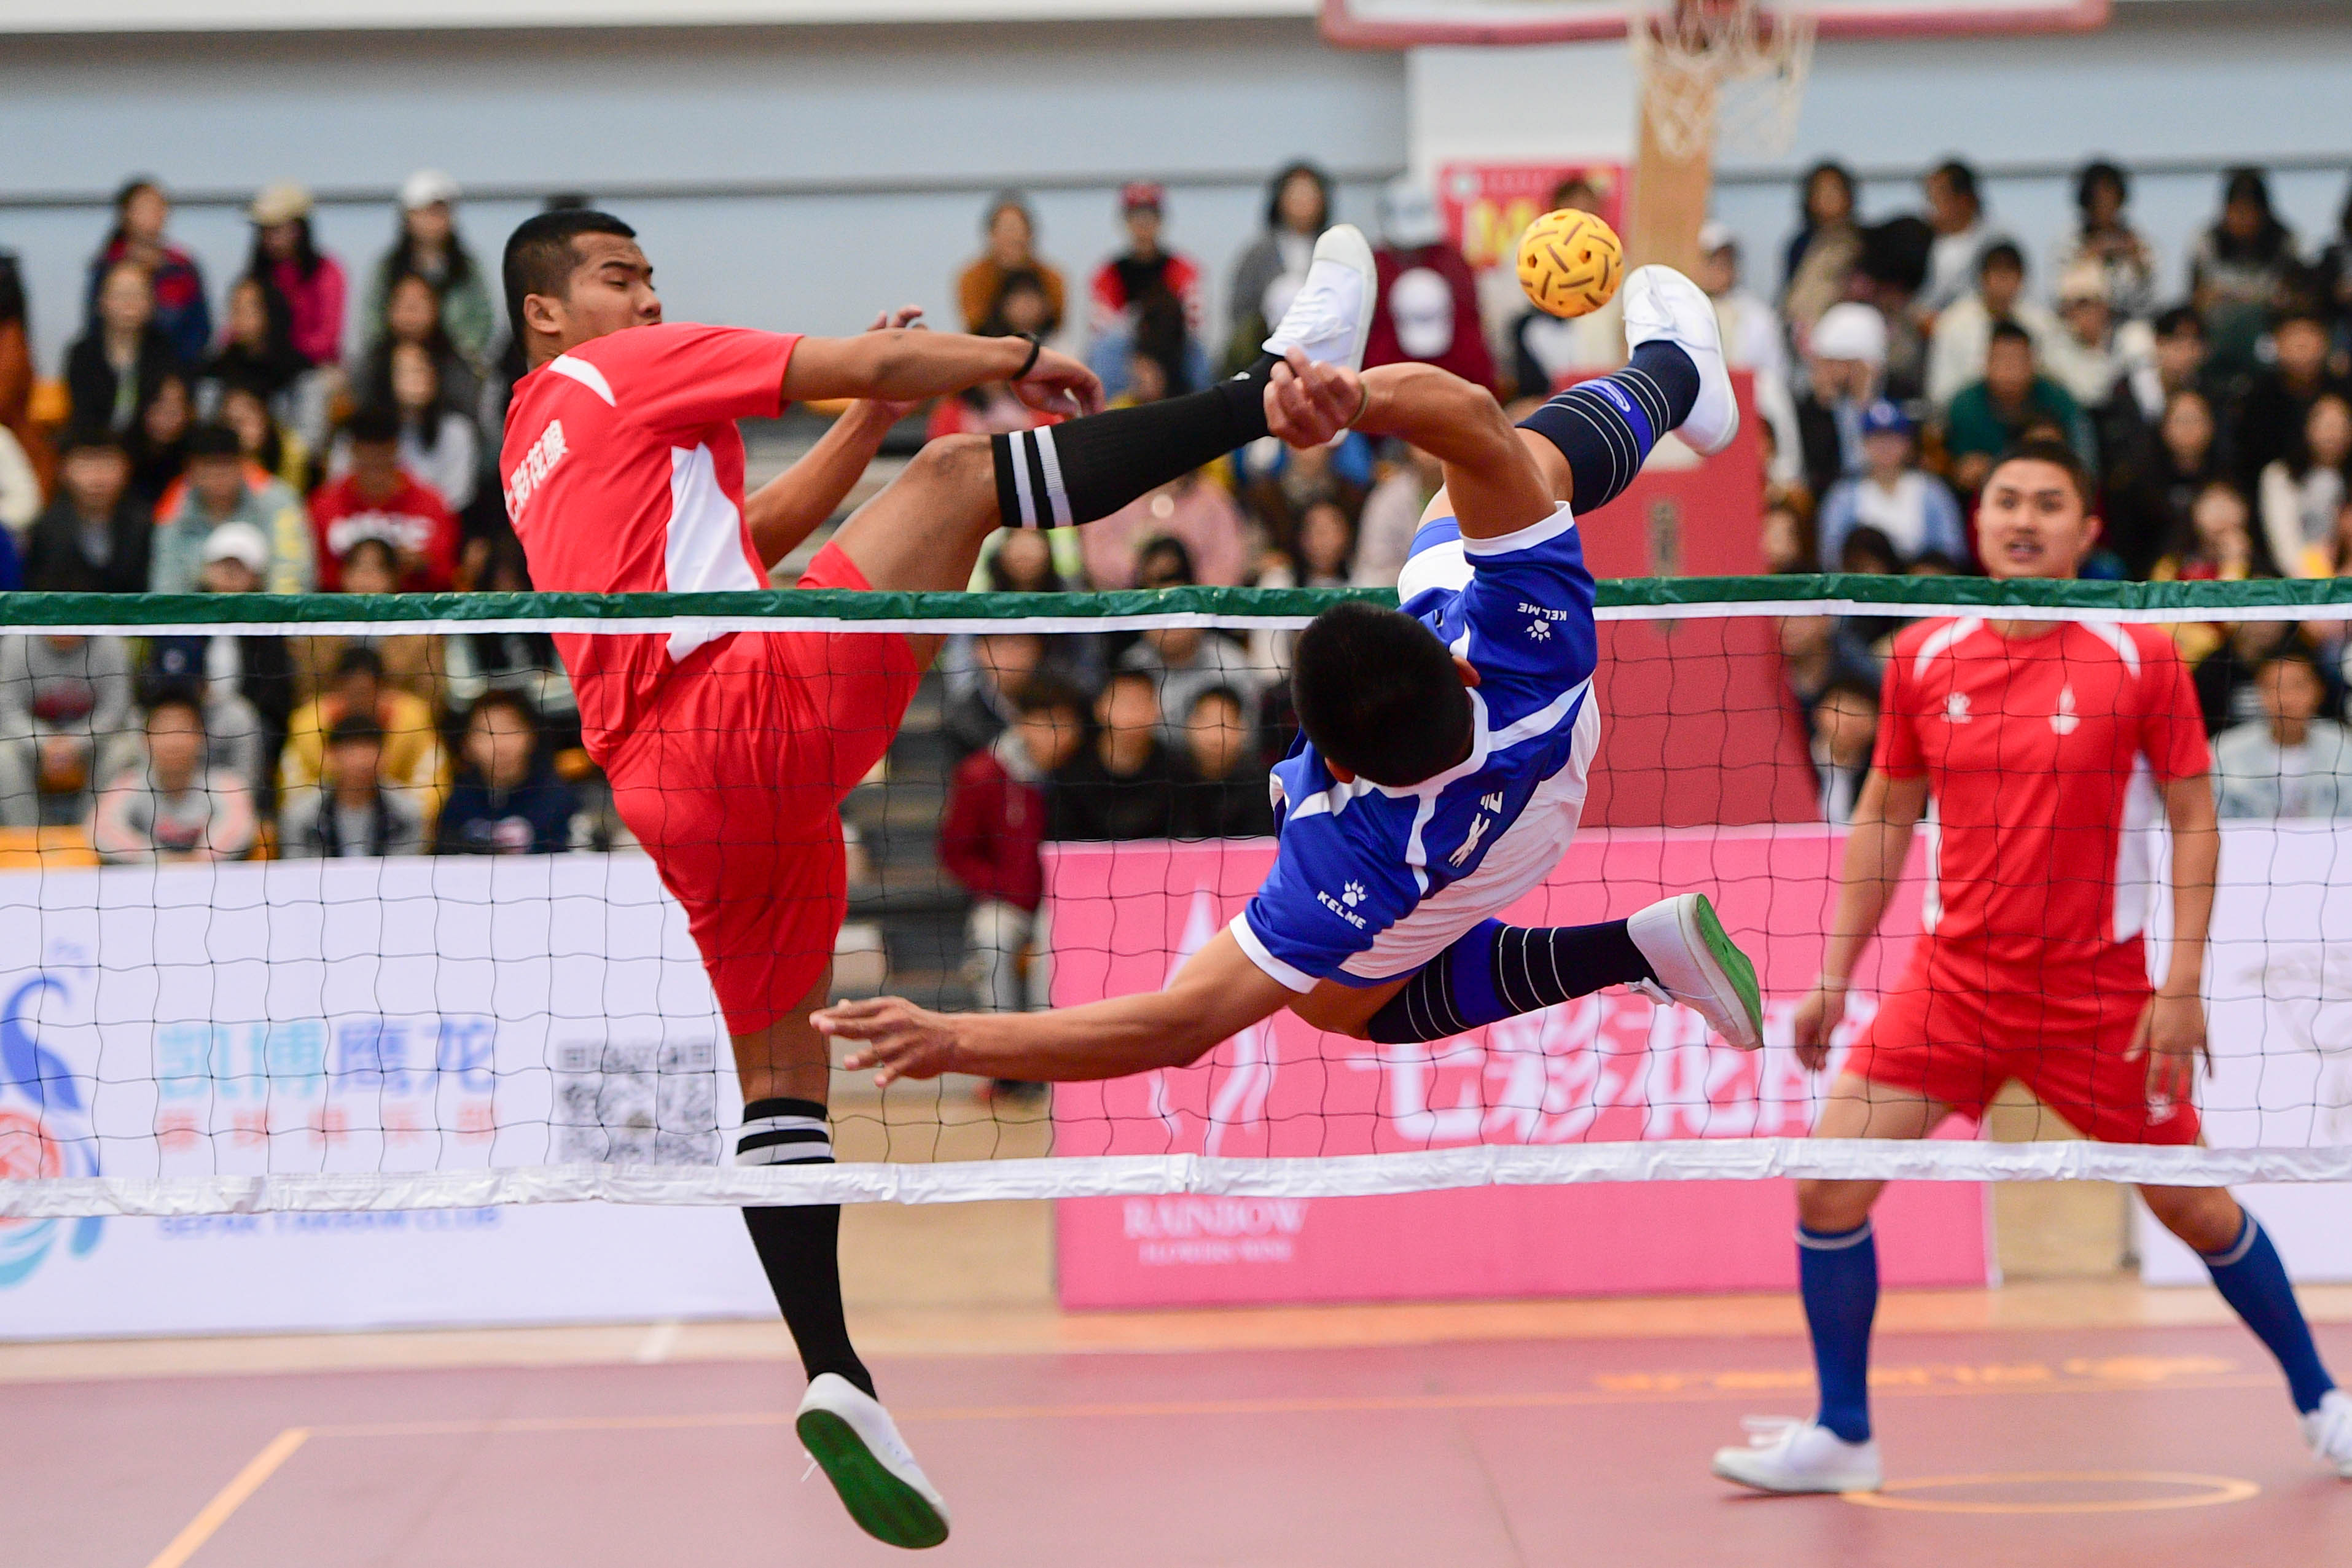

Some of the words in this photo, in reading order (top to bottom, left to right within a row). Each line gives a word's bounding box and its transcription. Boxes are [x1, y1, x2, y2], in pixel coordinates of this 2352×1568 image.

[1517, 603, 1567, 621] KELME
[1317, 891, 1366, 930] KELME
[158, 1020, 498, 1098] 凯博鹰龙
[1123, 1198, 1310, 1239] RAINBOW
